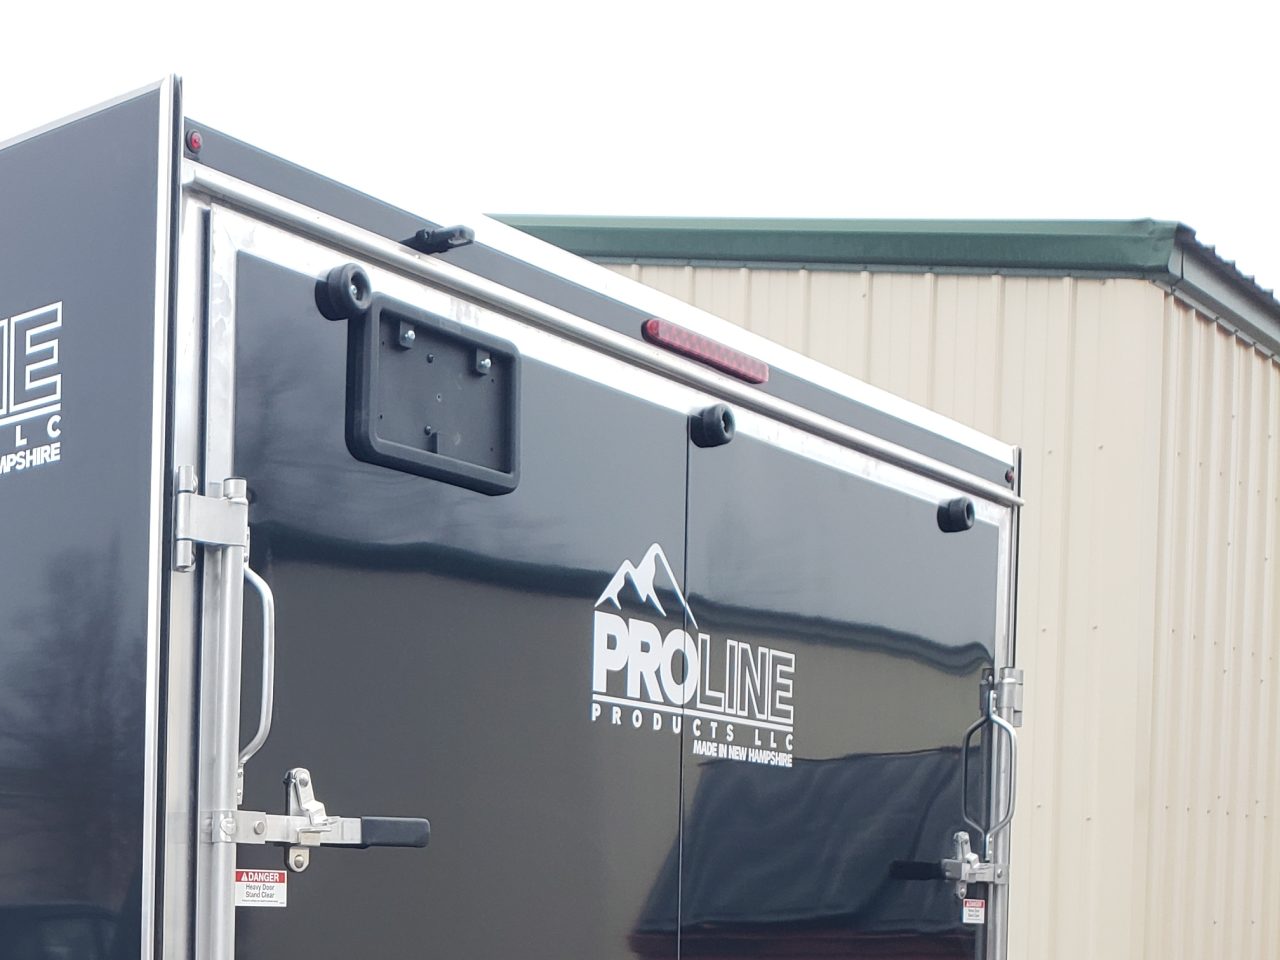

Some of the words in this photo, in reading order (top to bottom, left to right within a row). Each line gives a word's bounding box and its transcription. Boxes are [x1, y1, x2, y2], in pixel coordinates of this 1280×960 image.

[591, 703, 734, 742] PRODUCTS
[755, 729, 793, 750] LLC
[693, 739, 717, 756] MADE
[718, 744, 727, 758] IN
[728, 745, 747, 762] NEW
[748, 748, 793, 767] HAMPSHIRE
[248, 872, 280, 882] DANGER
